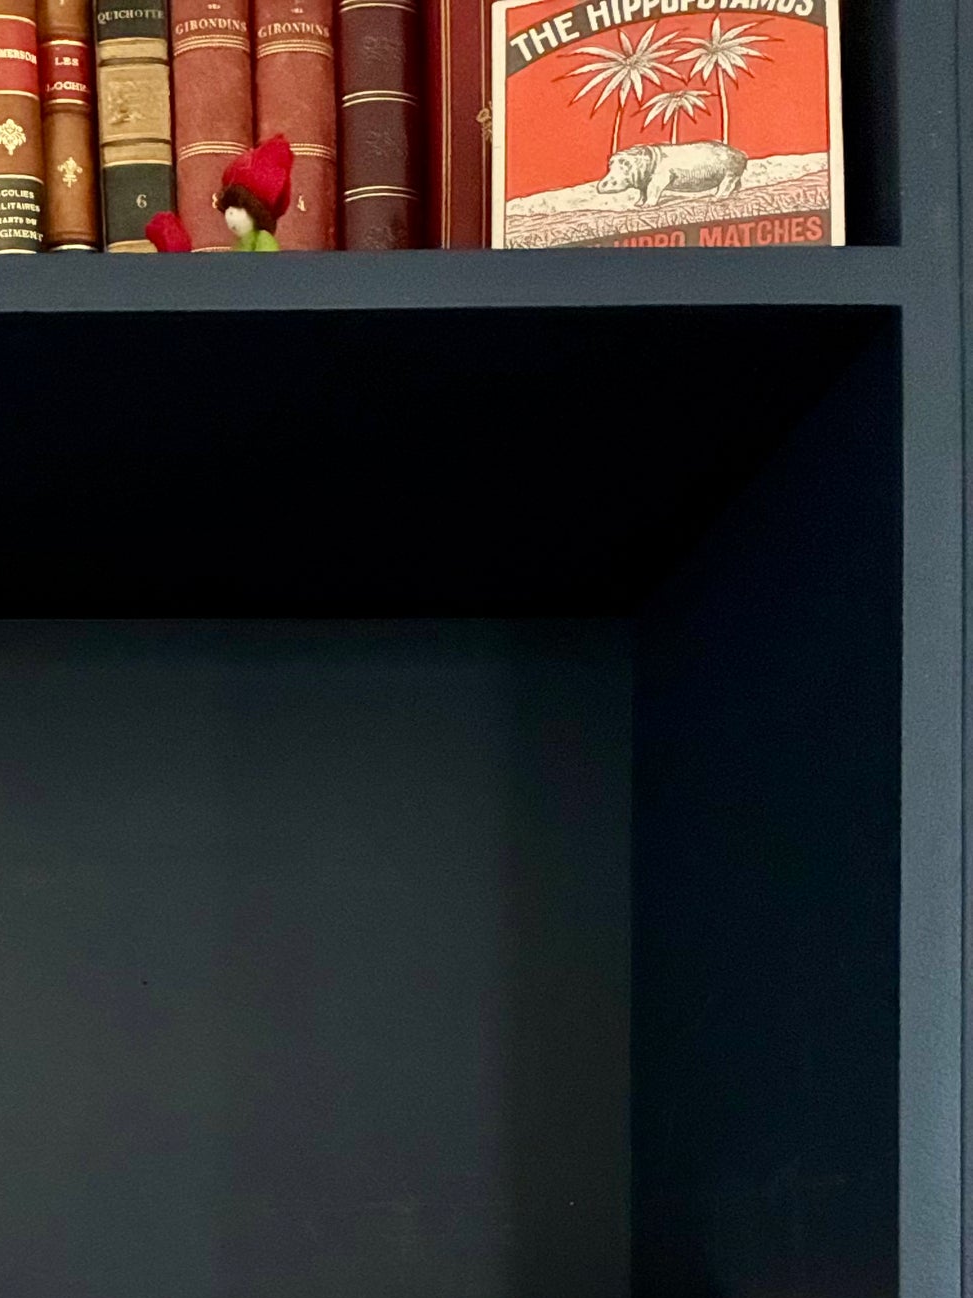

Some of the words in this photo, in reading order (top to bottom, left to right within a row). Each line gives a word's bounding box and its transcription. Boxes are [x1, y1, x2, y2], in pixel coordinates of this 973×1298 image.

[97, 9, 164, 25] QUICHOTTE
[175, 18, 247, 35] GIRONDINS
[257, 22, 330, 38] GIRONDINS
[510, 12, 580, 61] THE
[135, 194, 148, 208] 6
[699, 216, 824, 247] MATCHES
